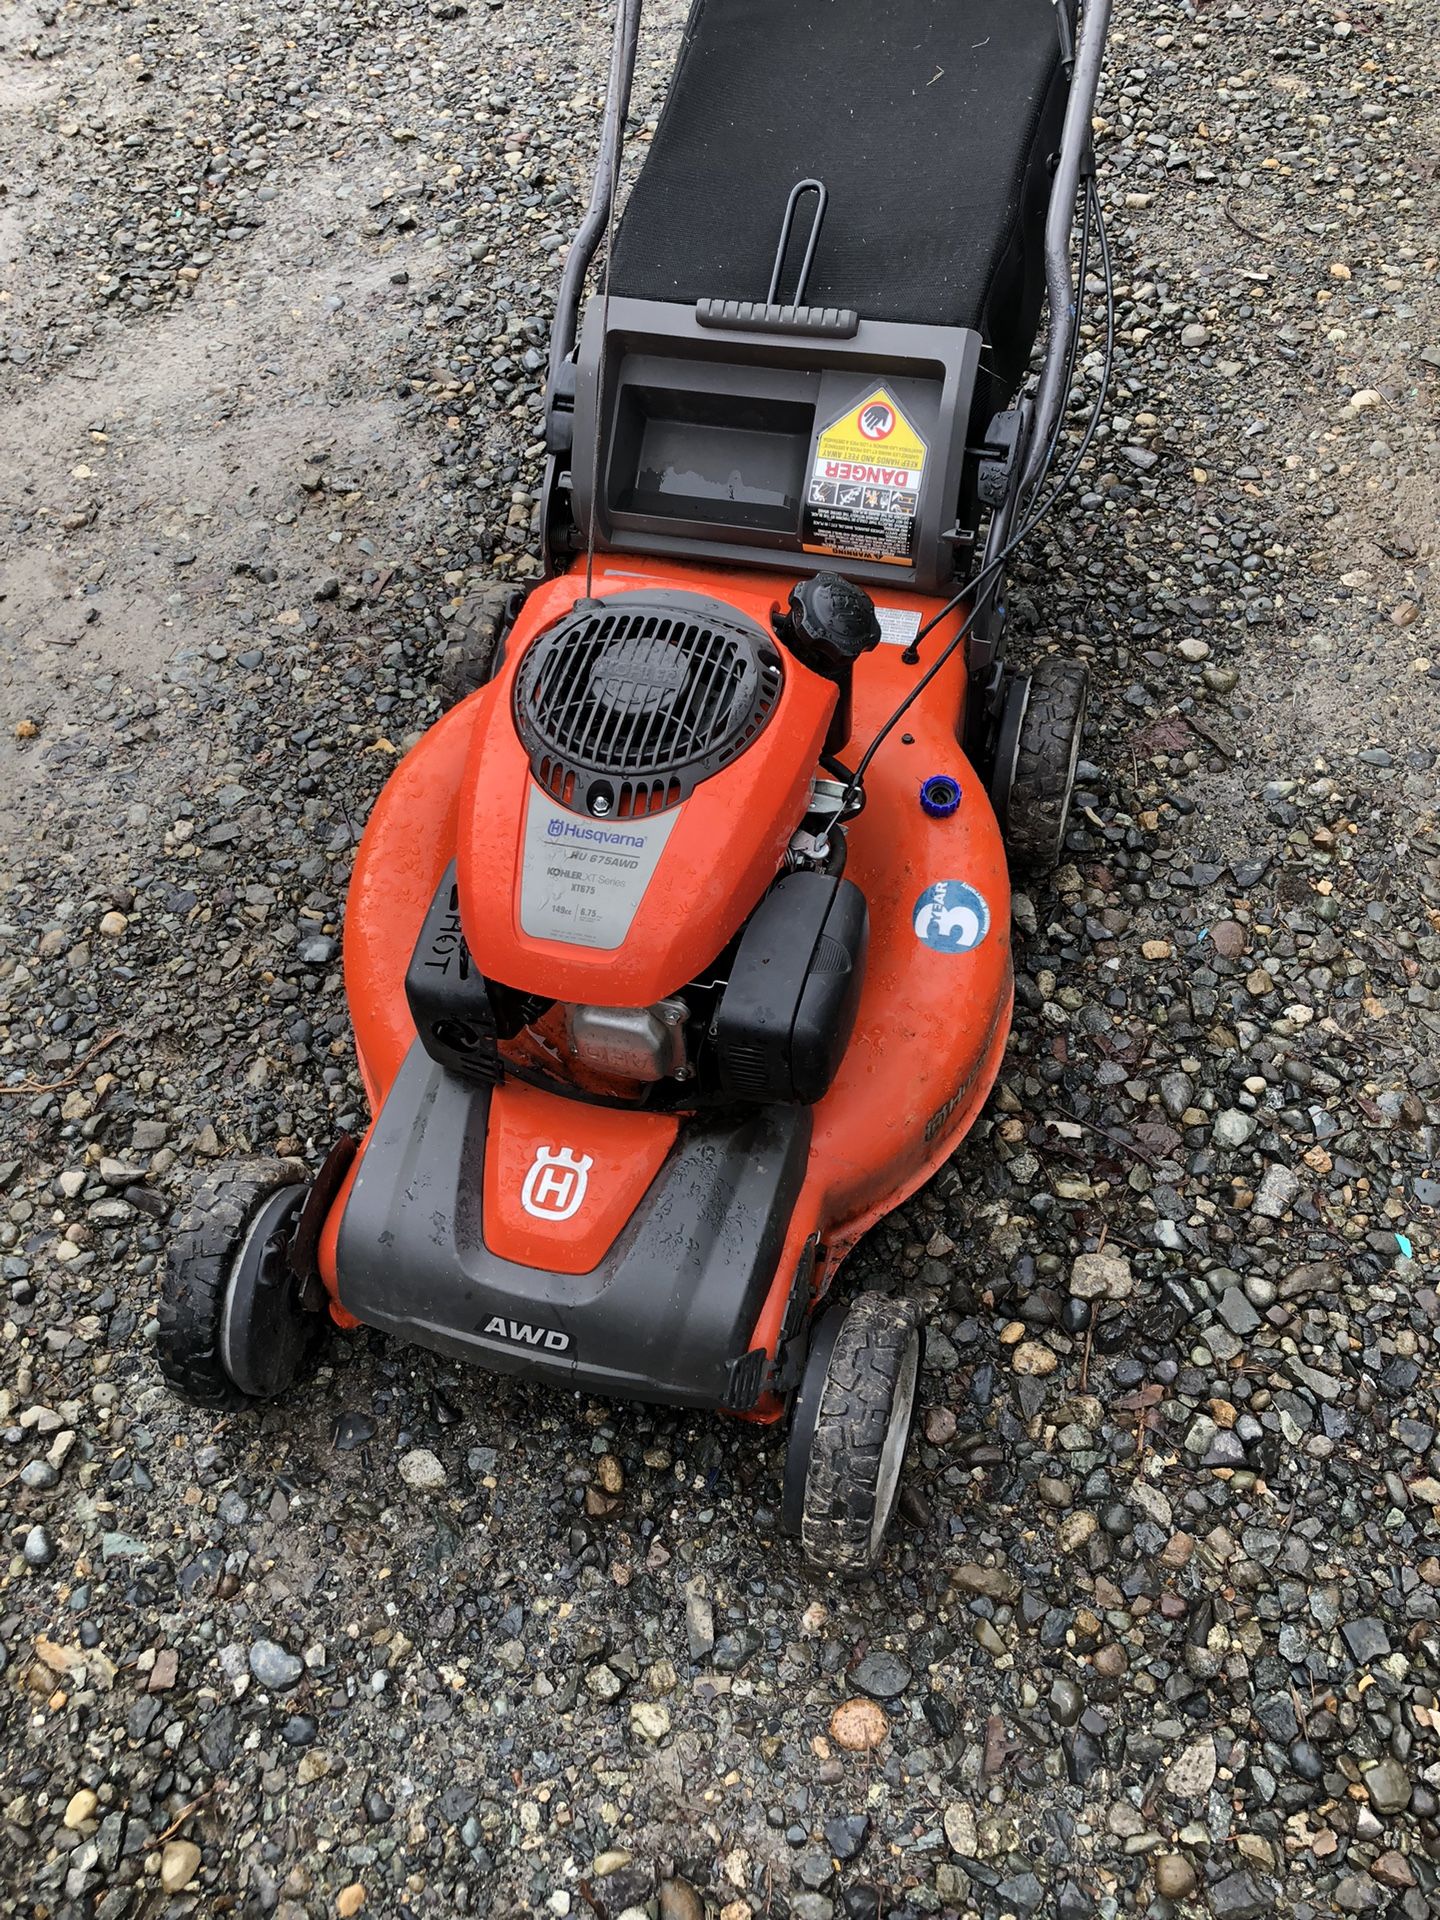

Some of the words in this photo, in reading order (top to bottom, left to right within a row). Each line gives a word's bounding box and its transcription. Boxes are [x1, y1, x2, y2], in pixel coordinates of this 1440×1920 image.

[821, 448, 842, 458] AWAY
[843, 451, 859, 460] FEET
[860, 453, 875, 462] AND
[876, 455, 900, 465] HANDS
[901, 459, 918, 468] KEEP
[824, 460, 909, 487] DANGER
[831, 548, 872, 558] WARNING
[563, 822, 645, 850] Husqvarna
[589, 853, 638, 870] 675AWD
[546, 866, 582, 881] KOHLER
[597, 875, 626, 887] Series
[570, 883, 596, 895] XT675
[931, 881, 948, 921] YEAR
[580, 907, 597, 917] 6.75
[915, 903, 979, 947] 3
[483, 1316, 571, 1352] AWD
